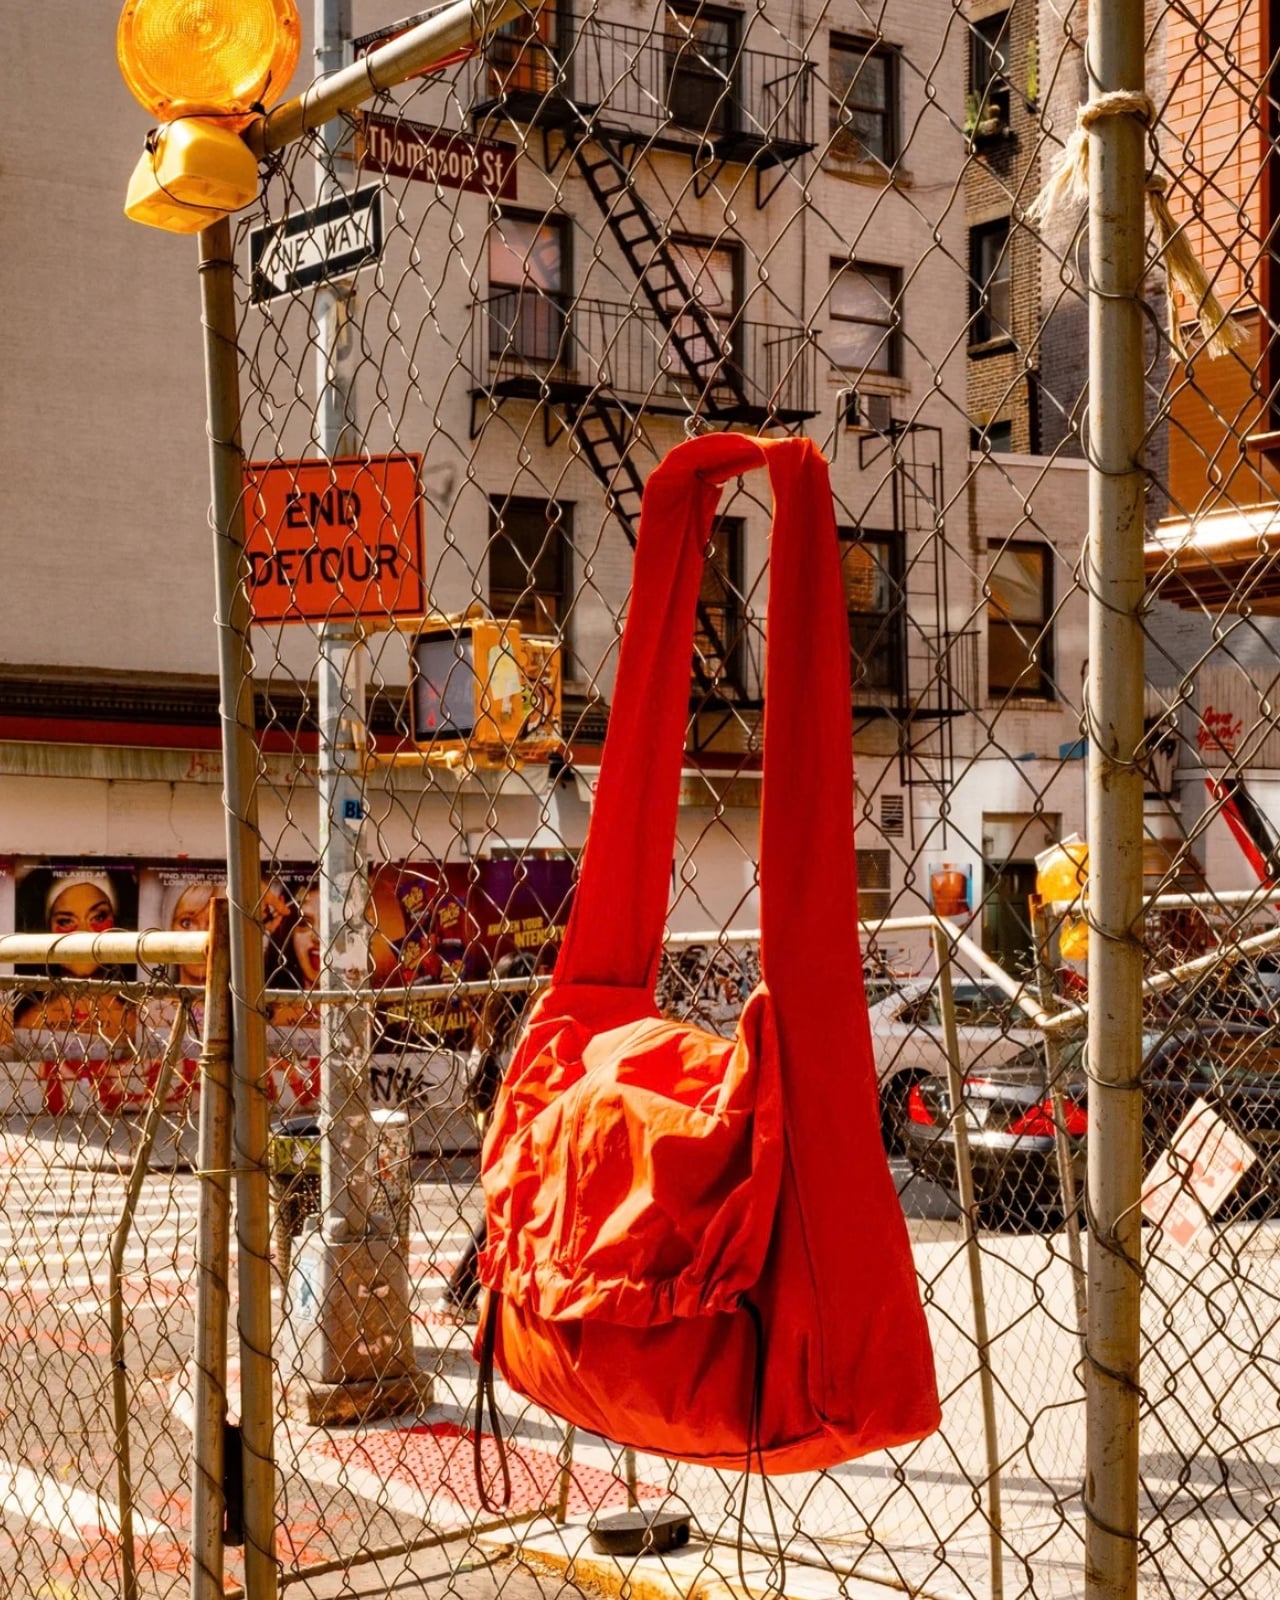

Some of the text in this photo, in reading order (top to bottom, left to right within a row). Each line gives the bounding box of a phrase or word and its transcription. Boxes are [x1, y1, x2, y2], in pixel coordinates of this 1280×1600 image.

[369, 126, 504, 186] Thompson St
[270, 237, 305, 274] ONE
[323, 215, 364, 253] WAY
[285, 490, 361, 529] END
[248, 544, 399, 588] DETOUR
[53, 870, 95, 878] RELAXED
[159, 868, 179, 879] FIND
[181, 869, 206, 880] YOUR
